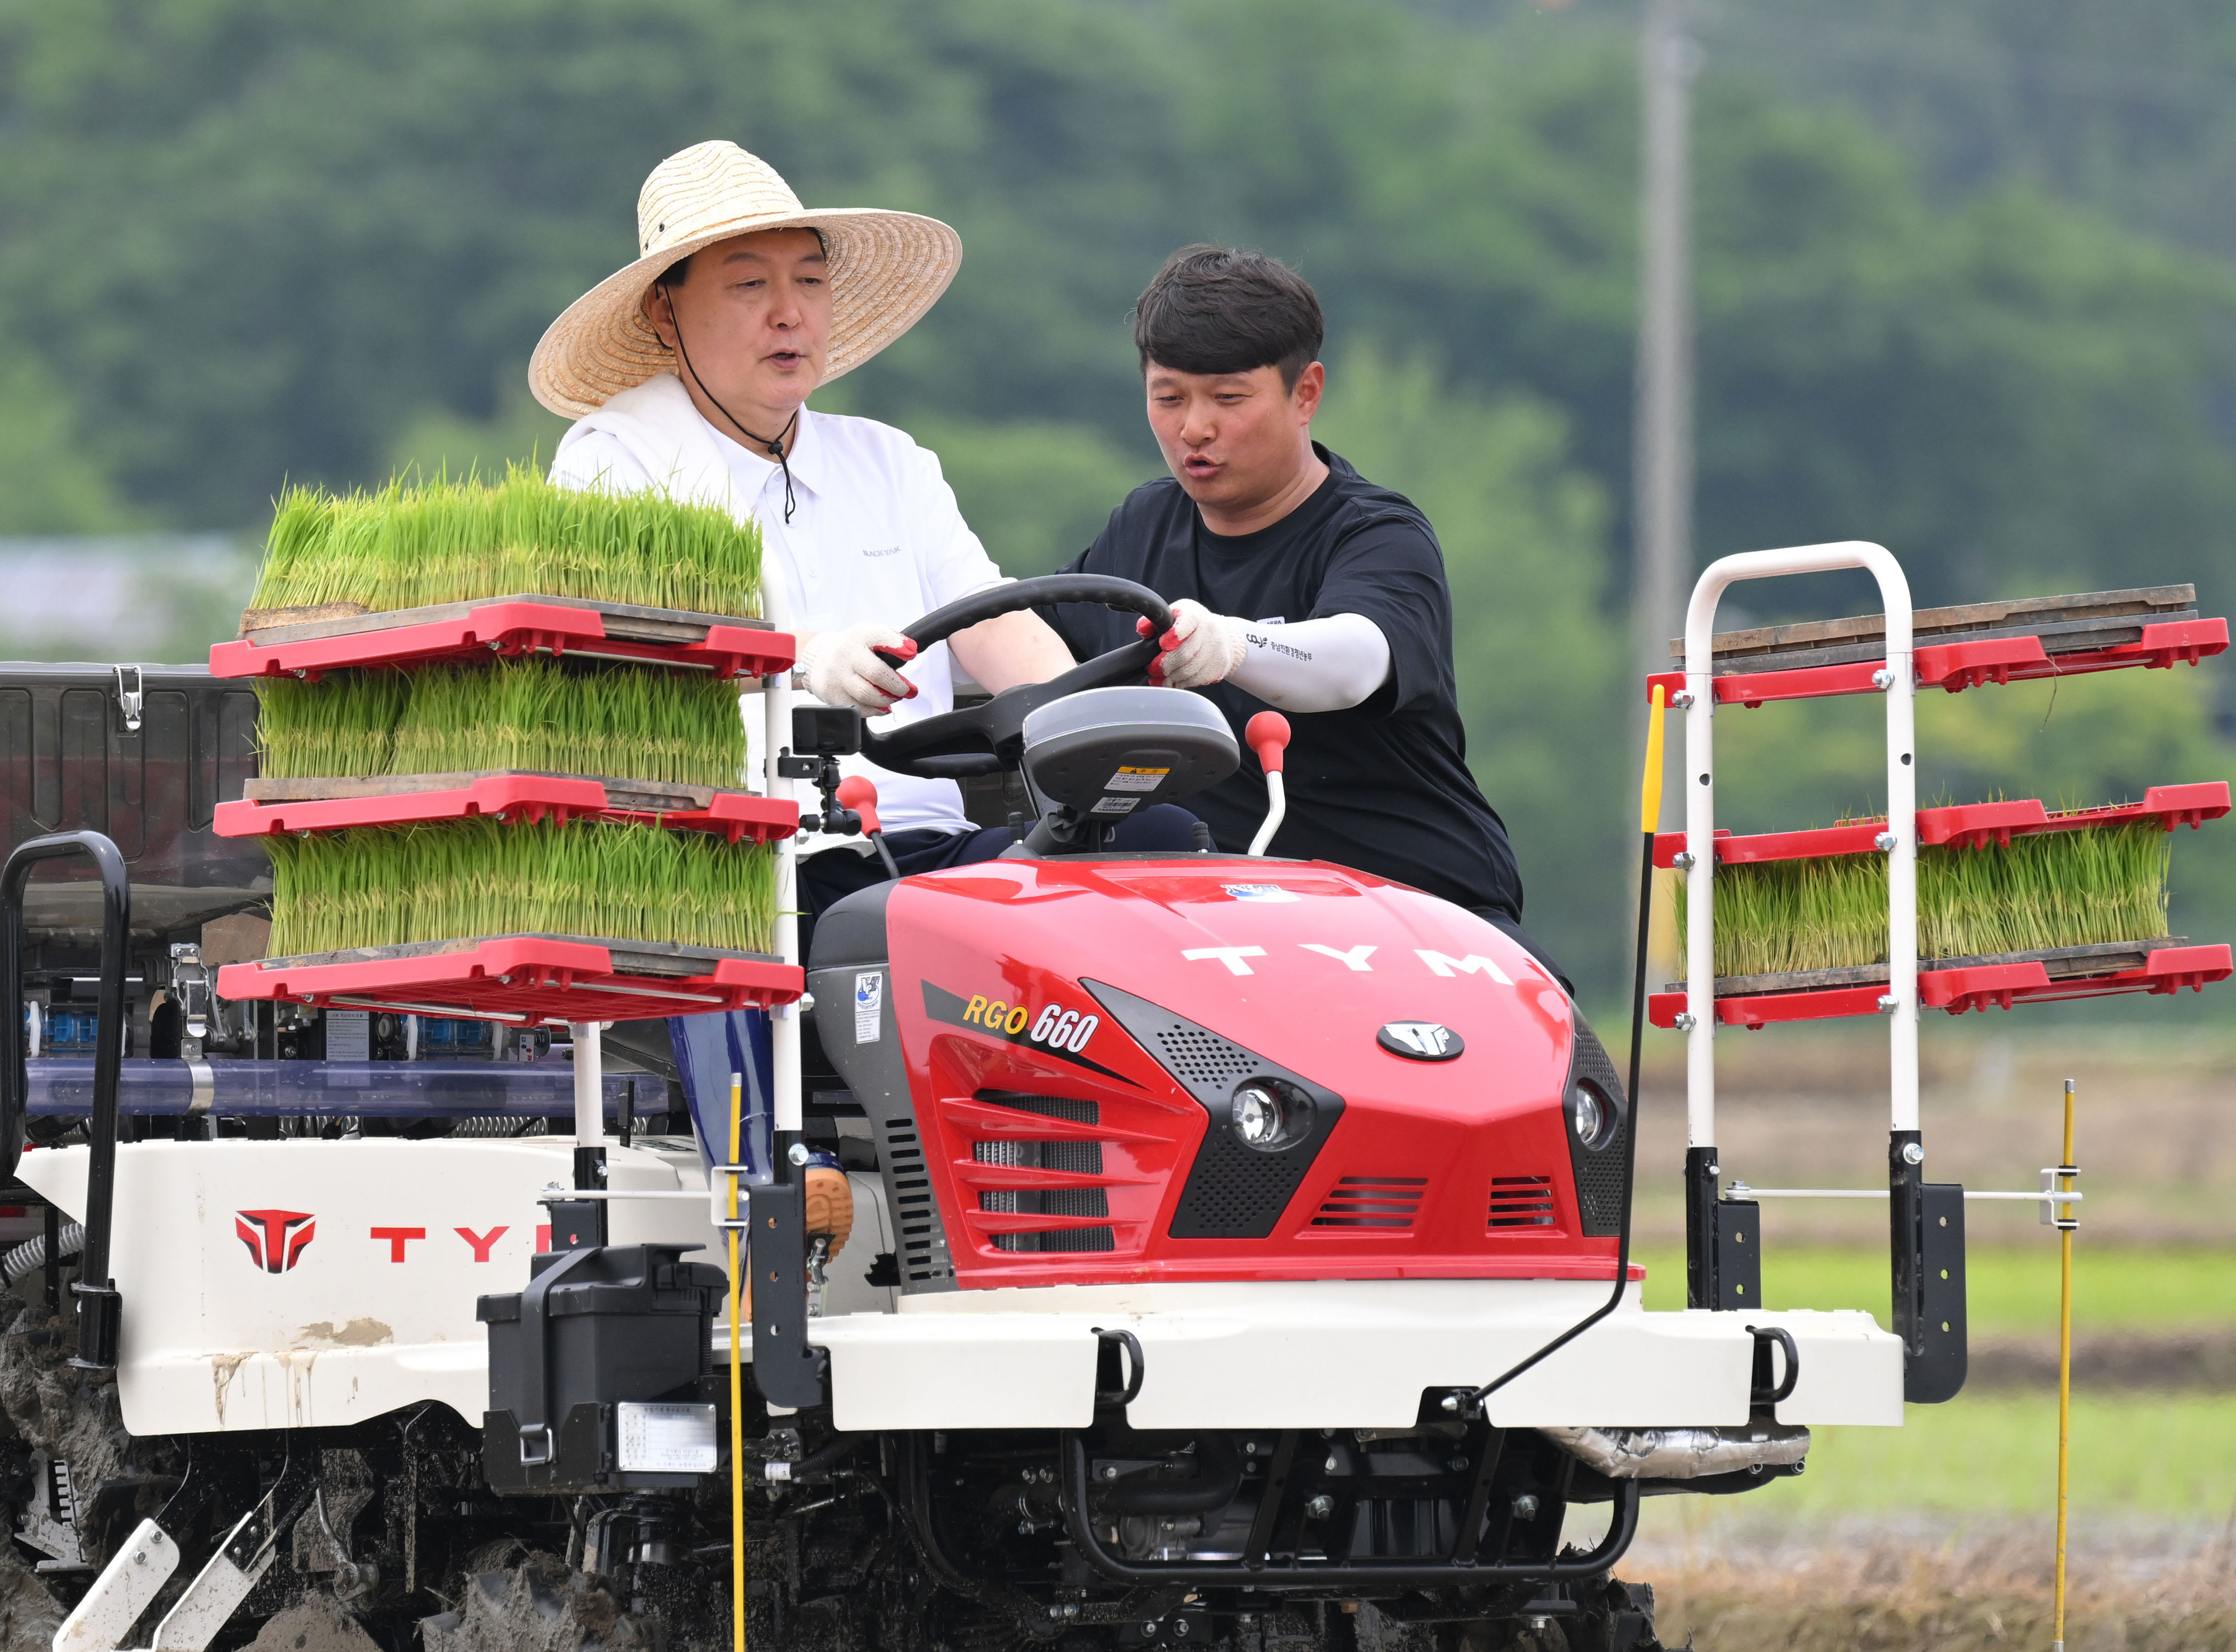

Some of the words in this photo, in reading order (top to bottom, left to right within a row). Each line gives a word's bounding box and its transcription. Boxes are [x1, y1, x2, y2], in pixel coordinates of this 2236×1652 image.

[1181, 943, 1514, 986] TYM
[963, 994, 1029, 1034] RGO
[1030, 1003, 1100, 1053] 660
[371, 1225, 552, 1263] TY
